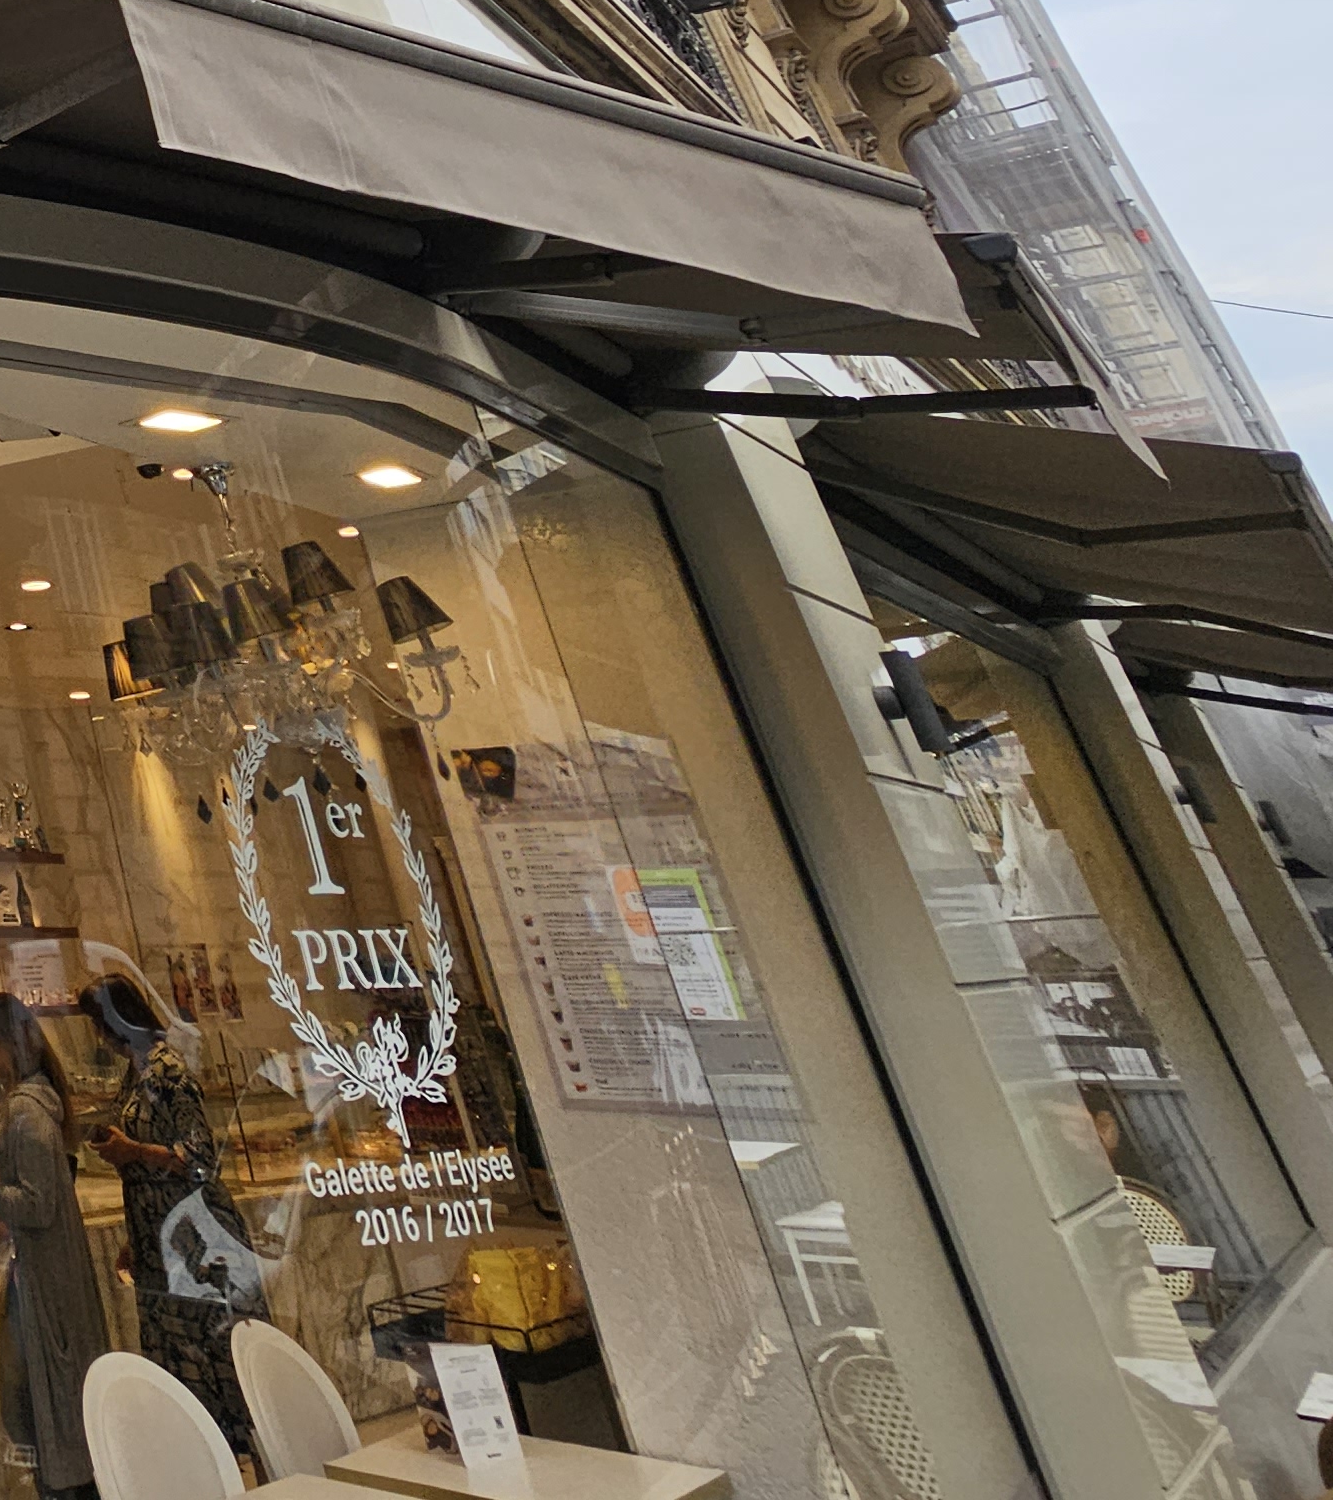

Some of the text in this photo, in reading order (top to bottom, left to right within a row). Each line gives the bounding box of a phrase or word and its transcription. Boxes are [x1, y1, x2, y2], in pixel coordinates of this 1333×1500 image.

[283, 776, 365, 895] 1er
[292, 928, 424, 991] PRIX
[305, 1145, 516, 1199] Galette de l'Elysée
[355, 1208, 420, 1247] 2016
[439, 1199, 495, 1239] 2017
